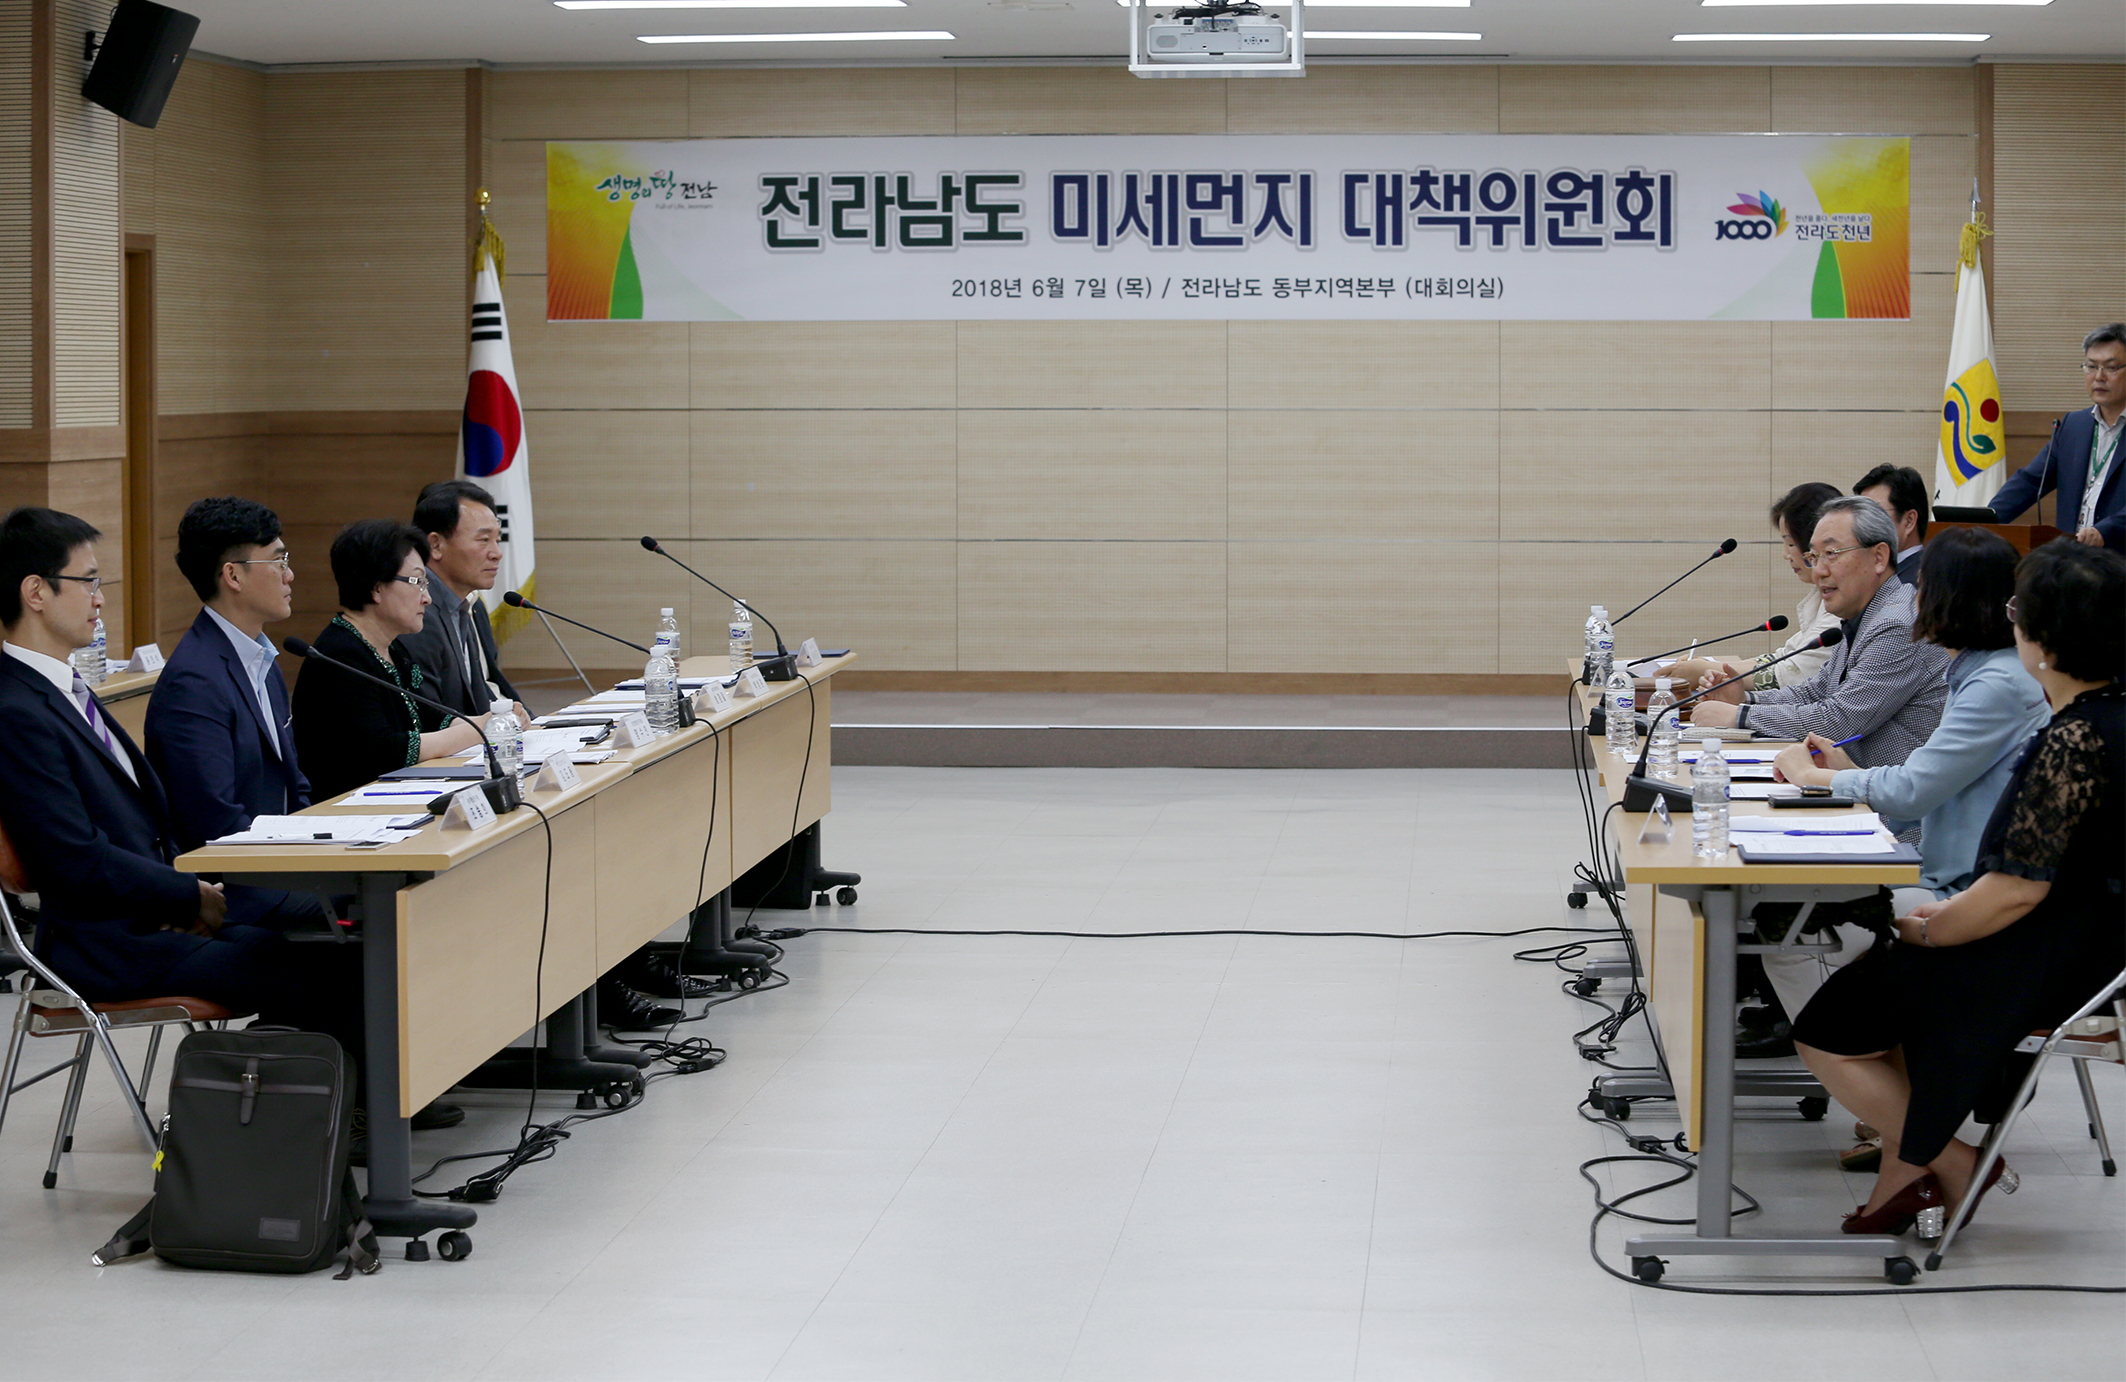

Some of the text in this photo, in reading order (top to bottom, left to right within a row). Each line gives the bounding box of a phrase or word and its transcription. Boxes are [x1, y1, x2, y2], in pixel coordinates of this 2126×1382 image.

[681, 181, 718, 199] 전남
[760, 168, 1675, 249] 전라남도 미세먼지 대책위원회
[1714, 220, 1772, 240] 1000
[1795, 224, 1871, 241] 전라도천년
[951, 276, 1504, 299] 2018년 6월 7일 (목) / 전라남도 동부지역본부 (대회의실)
